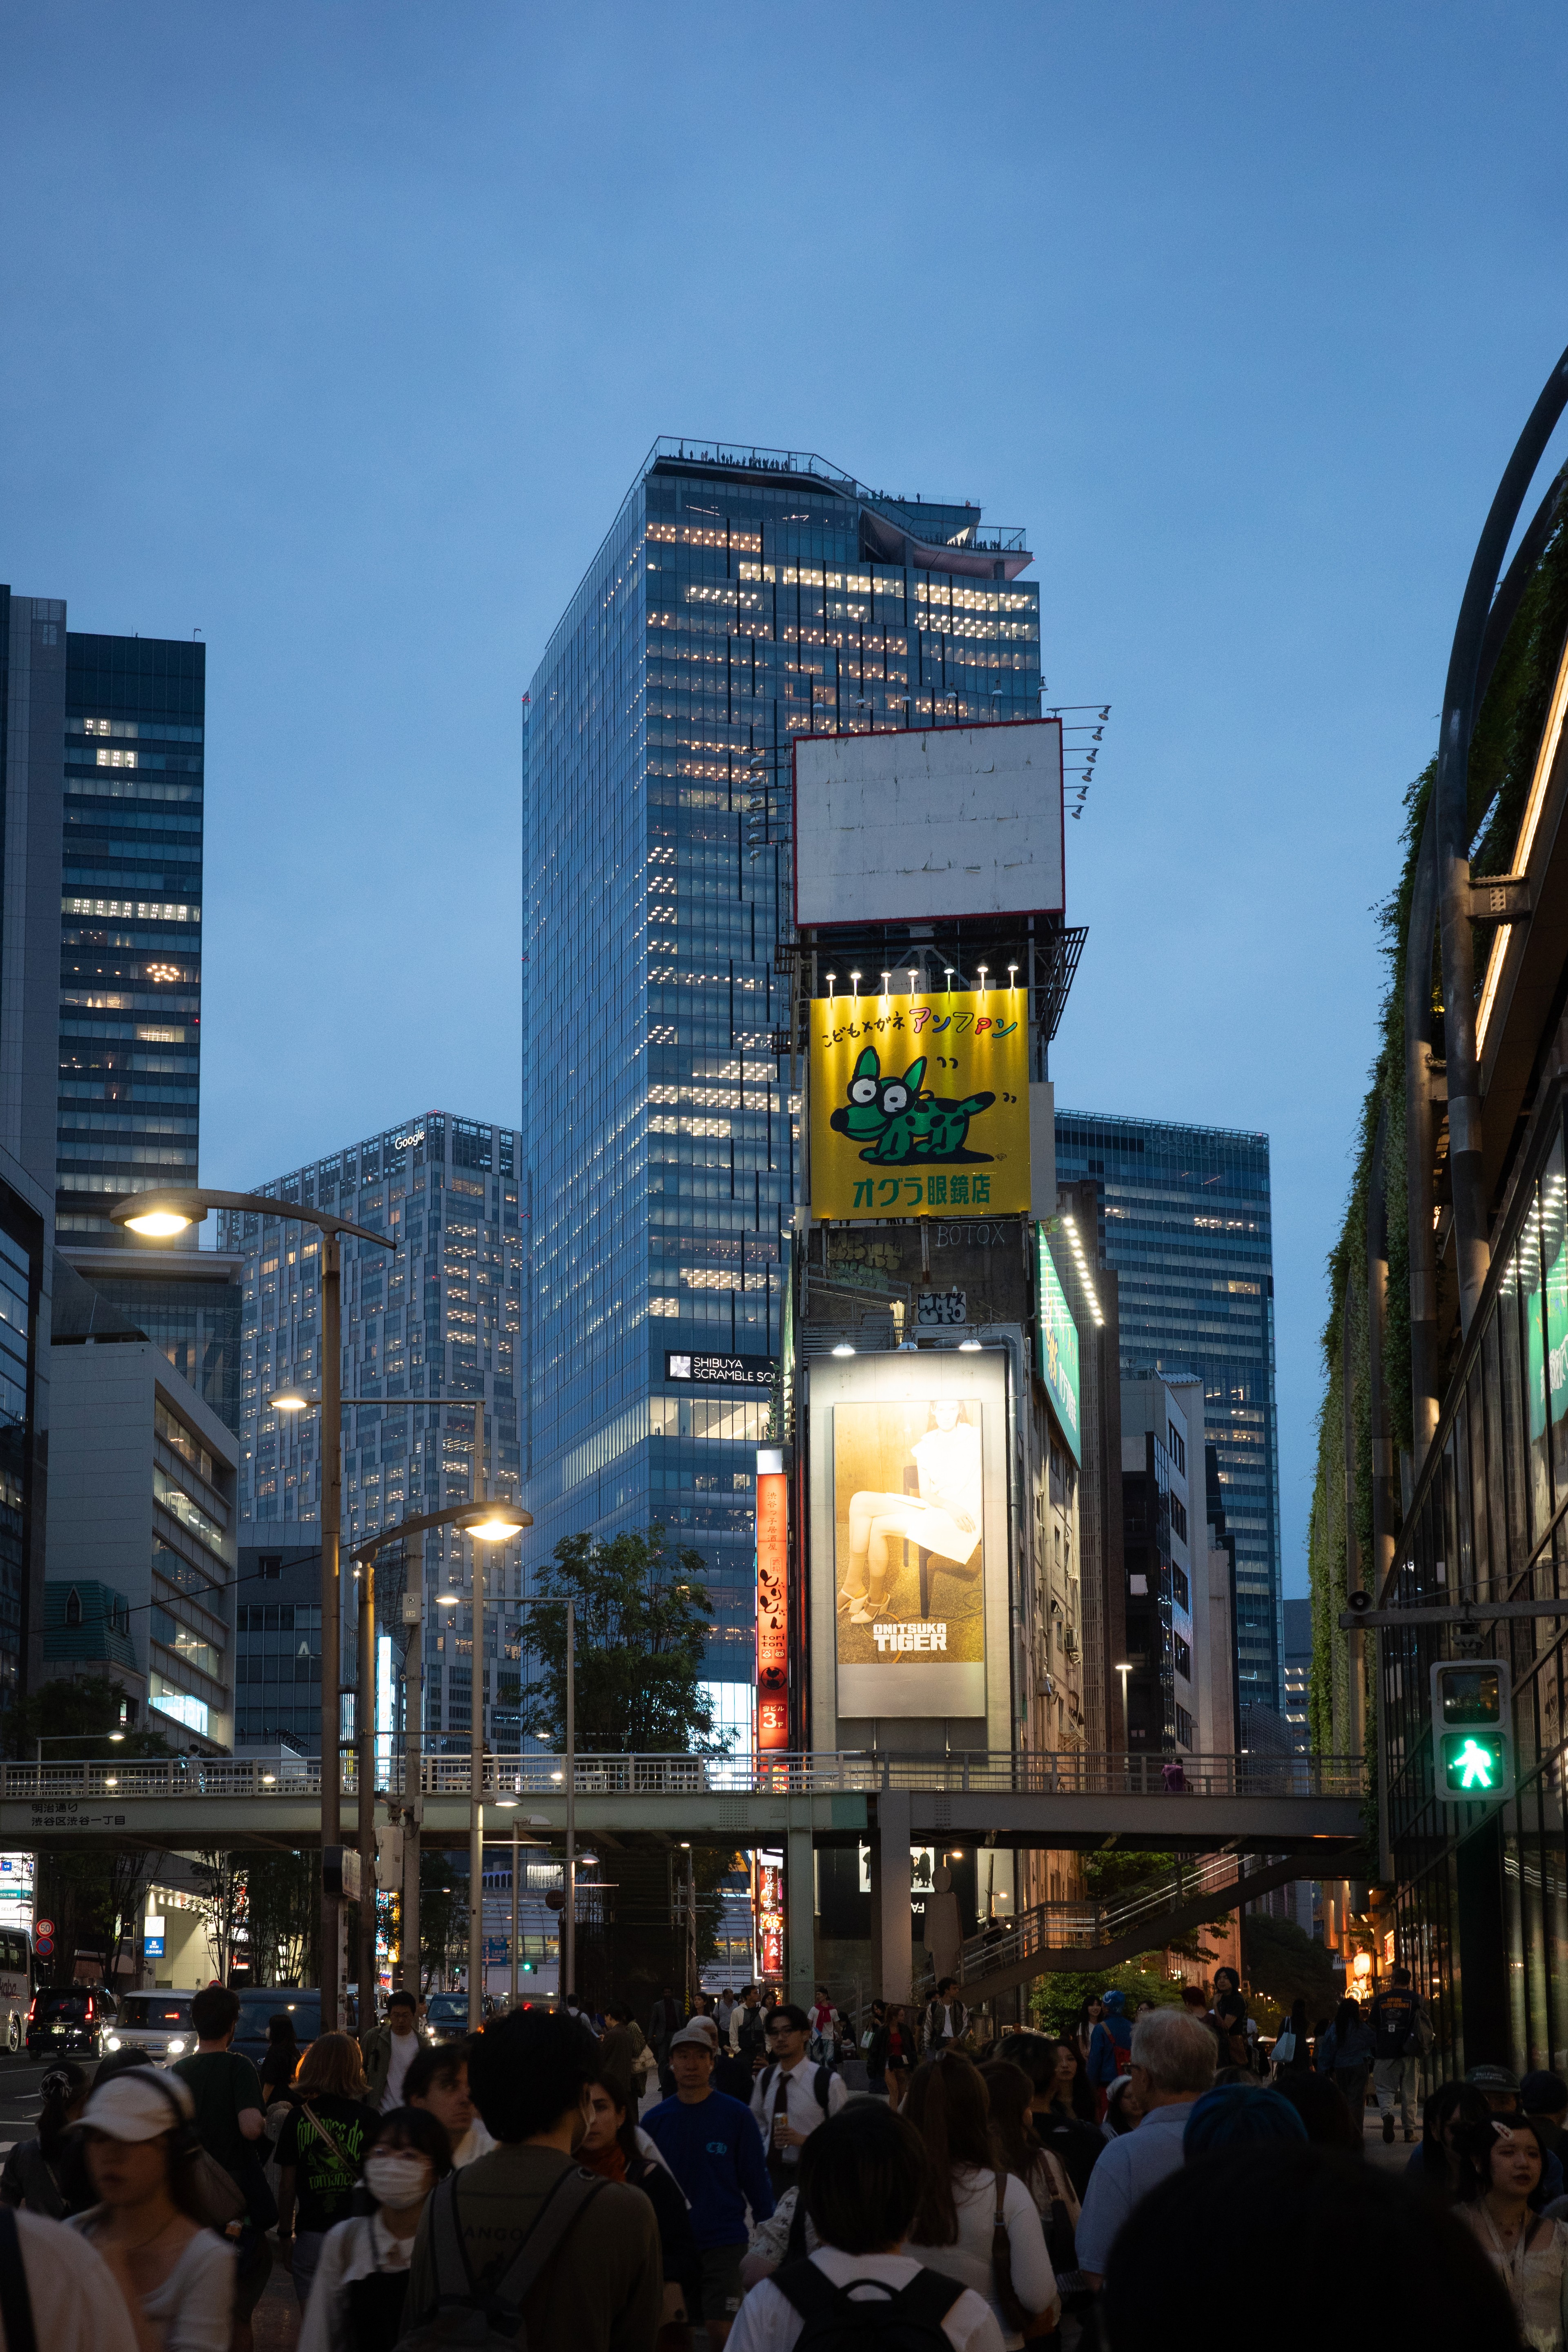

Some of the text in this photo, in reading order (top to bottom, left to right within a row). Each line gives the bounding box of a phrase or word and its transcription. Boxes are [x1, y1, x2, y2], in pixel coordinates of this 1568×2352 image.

[395, 1128, 425, 1150] Google
[853, 1174, 991, 1208] オグラ眼鏡店
[935, 1223, 1005, 1247] BOTOX
[694, 1357, 743, 1369] SHIBUYA
[694, 1369, 754, 1381] SCRAMBLE
[767, 1492, 777, 1551] 渋谷っ子居酒屋
[873, 1623, 947, 1634] ONITSUKA
[873, 1633, 947, 1652] TIGER
[763, 1712, 784, 1728] 3F
[32, 1803, 78, 1813] 明治通り
[31, 1816, 125, 1826] 渋谷区渋谷一丁目
[40, 1924, 50, 1932] 50
[464, 2226, 523, 2241] ANGO
